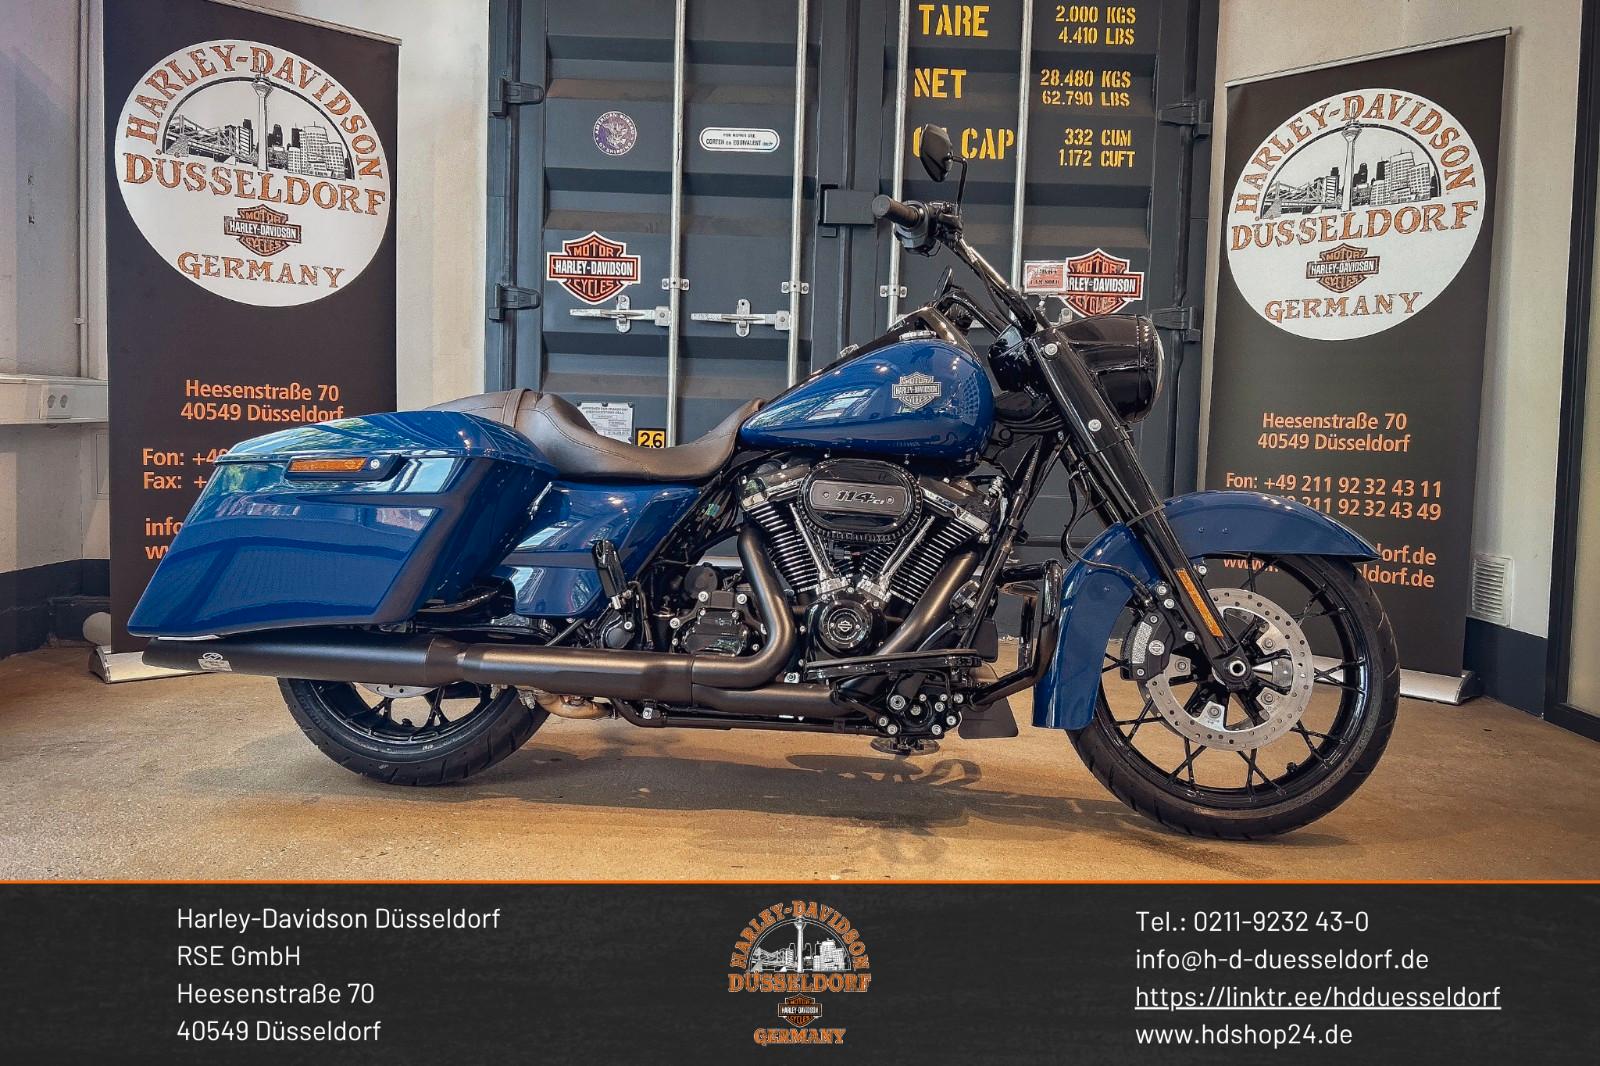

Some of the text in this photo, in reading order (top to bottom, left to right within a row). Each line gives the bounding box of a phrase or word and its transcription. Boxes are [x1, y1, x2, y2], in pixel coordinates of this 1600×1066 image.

[918, 4, 990, 37] TARE
[1055, 5, 1136, 24] 2.000 KGS
[1058, 27, 1135, 45] 4.410 LBS
[914, 68, 967, 98] NET
[1040, 69, 1132, 89] 28.480 KGS
[1042, 91, 1130, 107] 62.790 LBS
[126, 44, 384, 180] HARLEY-DAVIDSON
[961, 127, 1014, 160] CAP
[1064, 128, 1132, 147] 332 CUM
[1059, 149, 1136, 168] 1.172 CUFT
[1235, 93, 1477, 214] HARLEY-DAVIDSON
[123, 149, 386, 216] DÜSSELDORF
[229, 220, 297, 239] HARLEY-DAVIDSON
[1231, 201, 1479, 251] DÜSSELDORF
[573, 242, 615, 257] MOTOR
[177, 251, 344, 288] GERMANY
[555, 260, 633, 277] HARLEY-DAVIDSON
[1076, 257, 1118, 274] MOTOR
[1311, 260, 1375, 276] HARLEY-DAVIDSON
[574, 279, 615, 298] CYCLES
[1067, 277, 1137, 293] RLEY-DAVIDSON
[1075, 296, 1117, 314] CYCLES
[1265, 291, 1423, 323] GERMANY
[185, 380, 340, 401] Heesenstraße 70
[180, 402, 344, 423] 40549 Düsseldorf
[1262, 412, 1408, 430] Heesenstraße 70
[1257, 433, 1411, 452] 40549 Düsseldorf
[142, 448, 185, 466] Fon:
[143, 472, 183, 490] Fax:
[1225, 472, 1258, 489] Fon:
[1263, 474, 1297, 491] +49
[1302, 476, 1332, 493] 211
[1420, 481, 1442, 498] 11
[1416, 503, 1442, 521] 49
